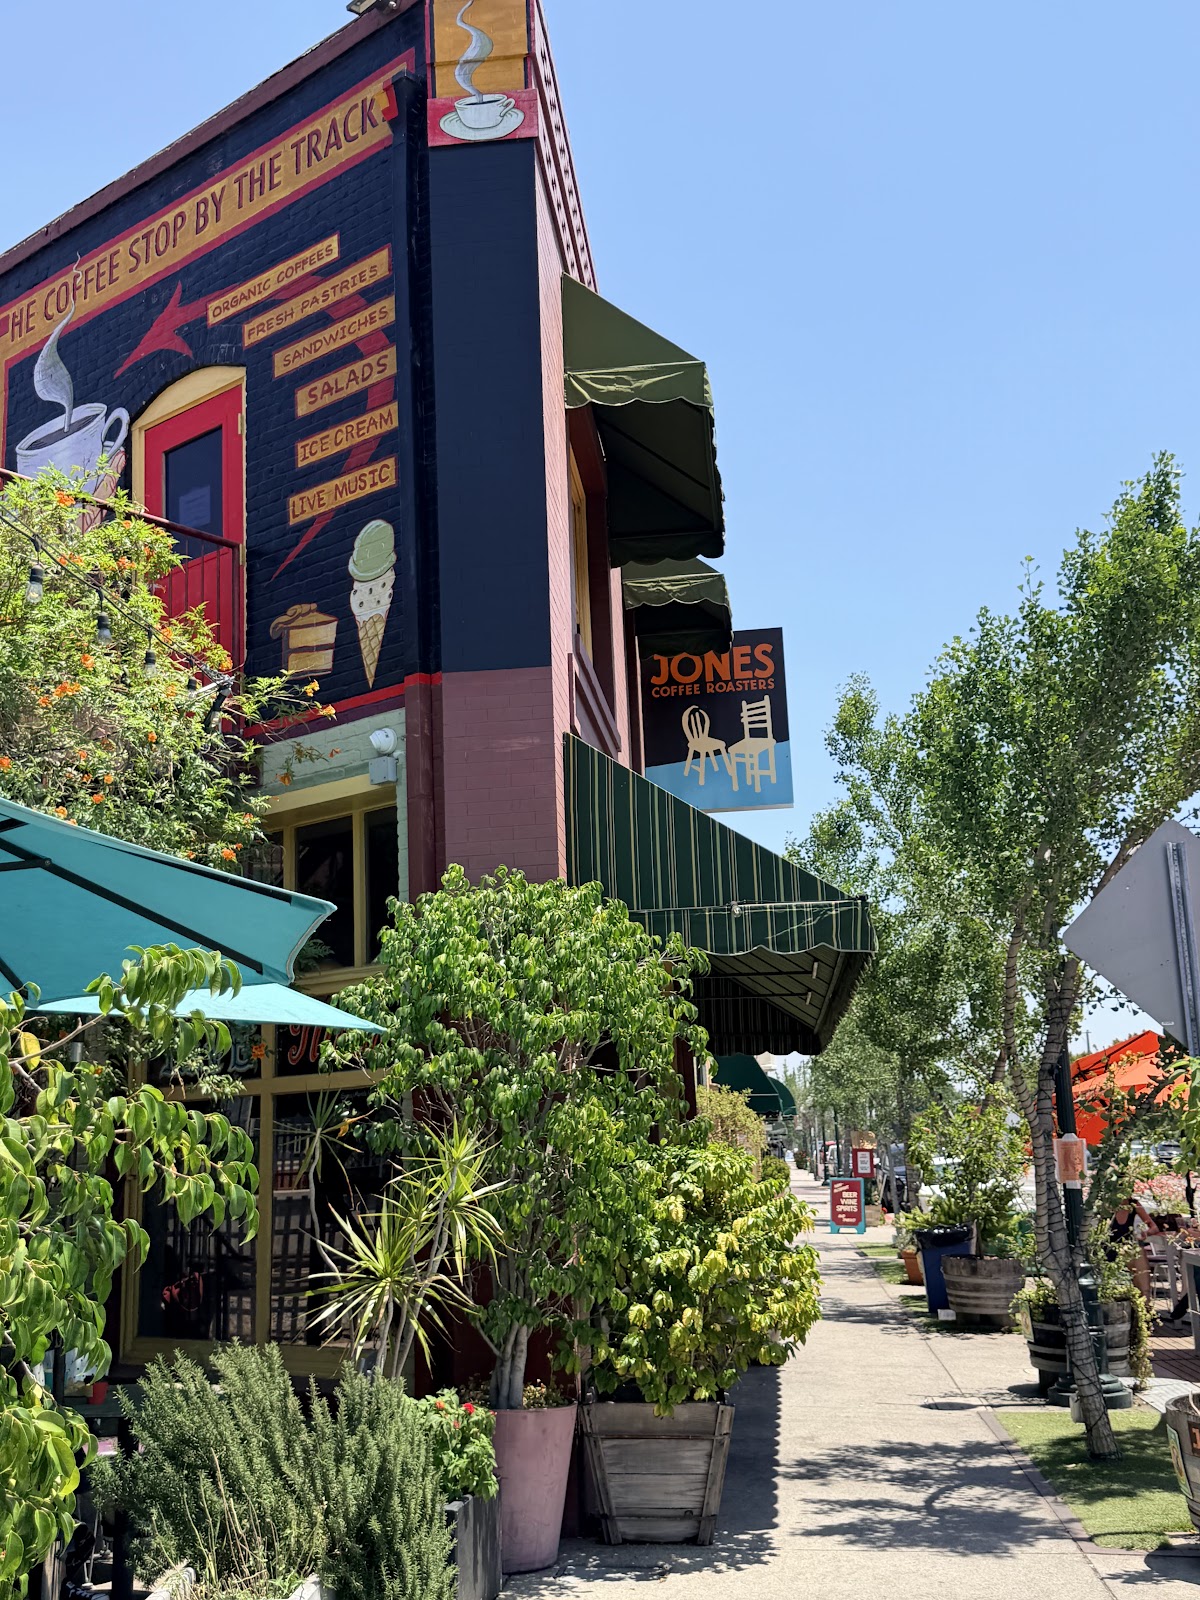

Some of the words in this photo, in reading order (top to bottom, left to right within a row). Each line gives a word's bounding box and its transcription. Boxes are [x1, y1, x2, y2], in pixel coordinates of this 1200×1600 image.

[44, 249, 119, 322] COFFEE
[128, 211, 186, 273] STOP
[195, 186, 226, 236] BY
[233, 152, 282, 209] THE
[291, 96, 386, 176] TRACK
[212, 278, 271, 318] ORGANIC
[277, 244, 333, 283] COFFEES
[247, 310, 294, 340] FRESH
[301, 265, 378, 313] PASTRIES
[282, 306, 388, 368] SANDWICHES
[307, 355, 389, 405] SALADS
[299, 435, 330, 461] ICE
[334, 409, 393, 445] CREAM
[291, 490, 326, 520] LIVE
[334, 464, 391, 502] MUSIC
[651, 643, 775, 685] JONES
[651, 684, 700, 698] COFFEE
[706, 678, 775, 693] ROASTERS
